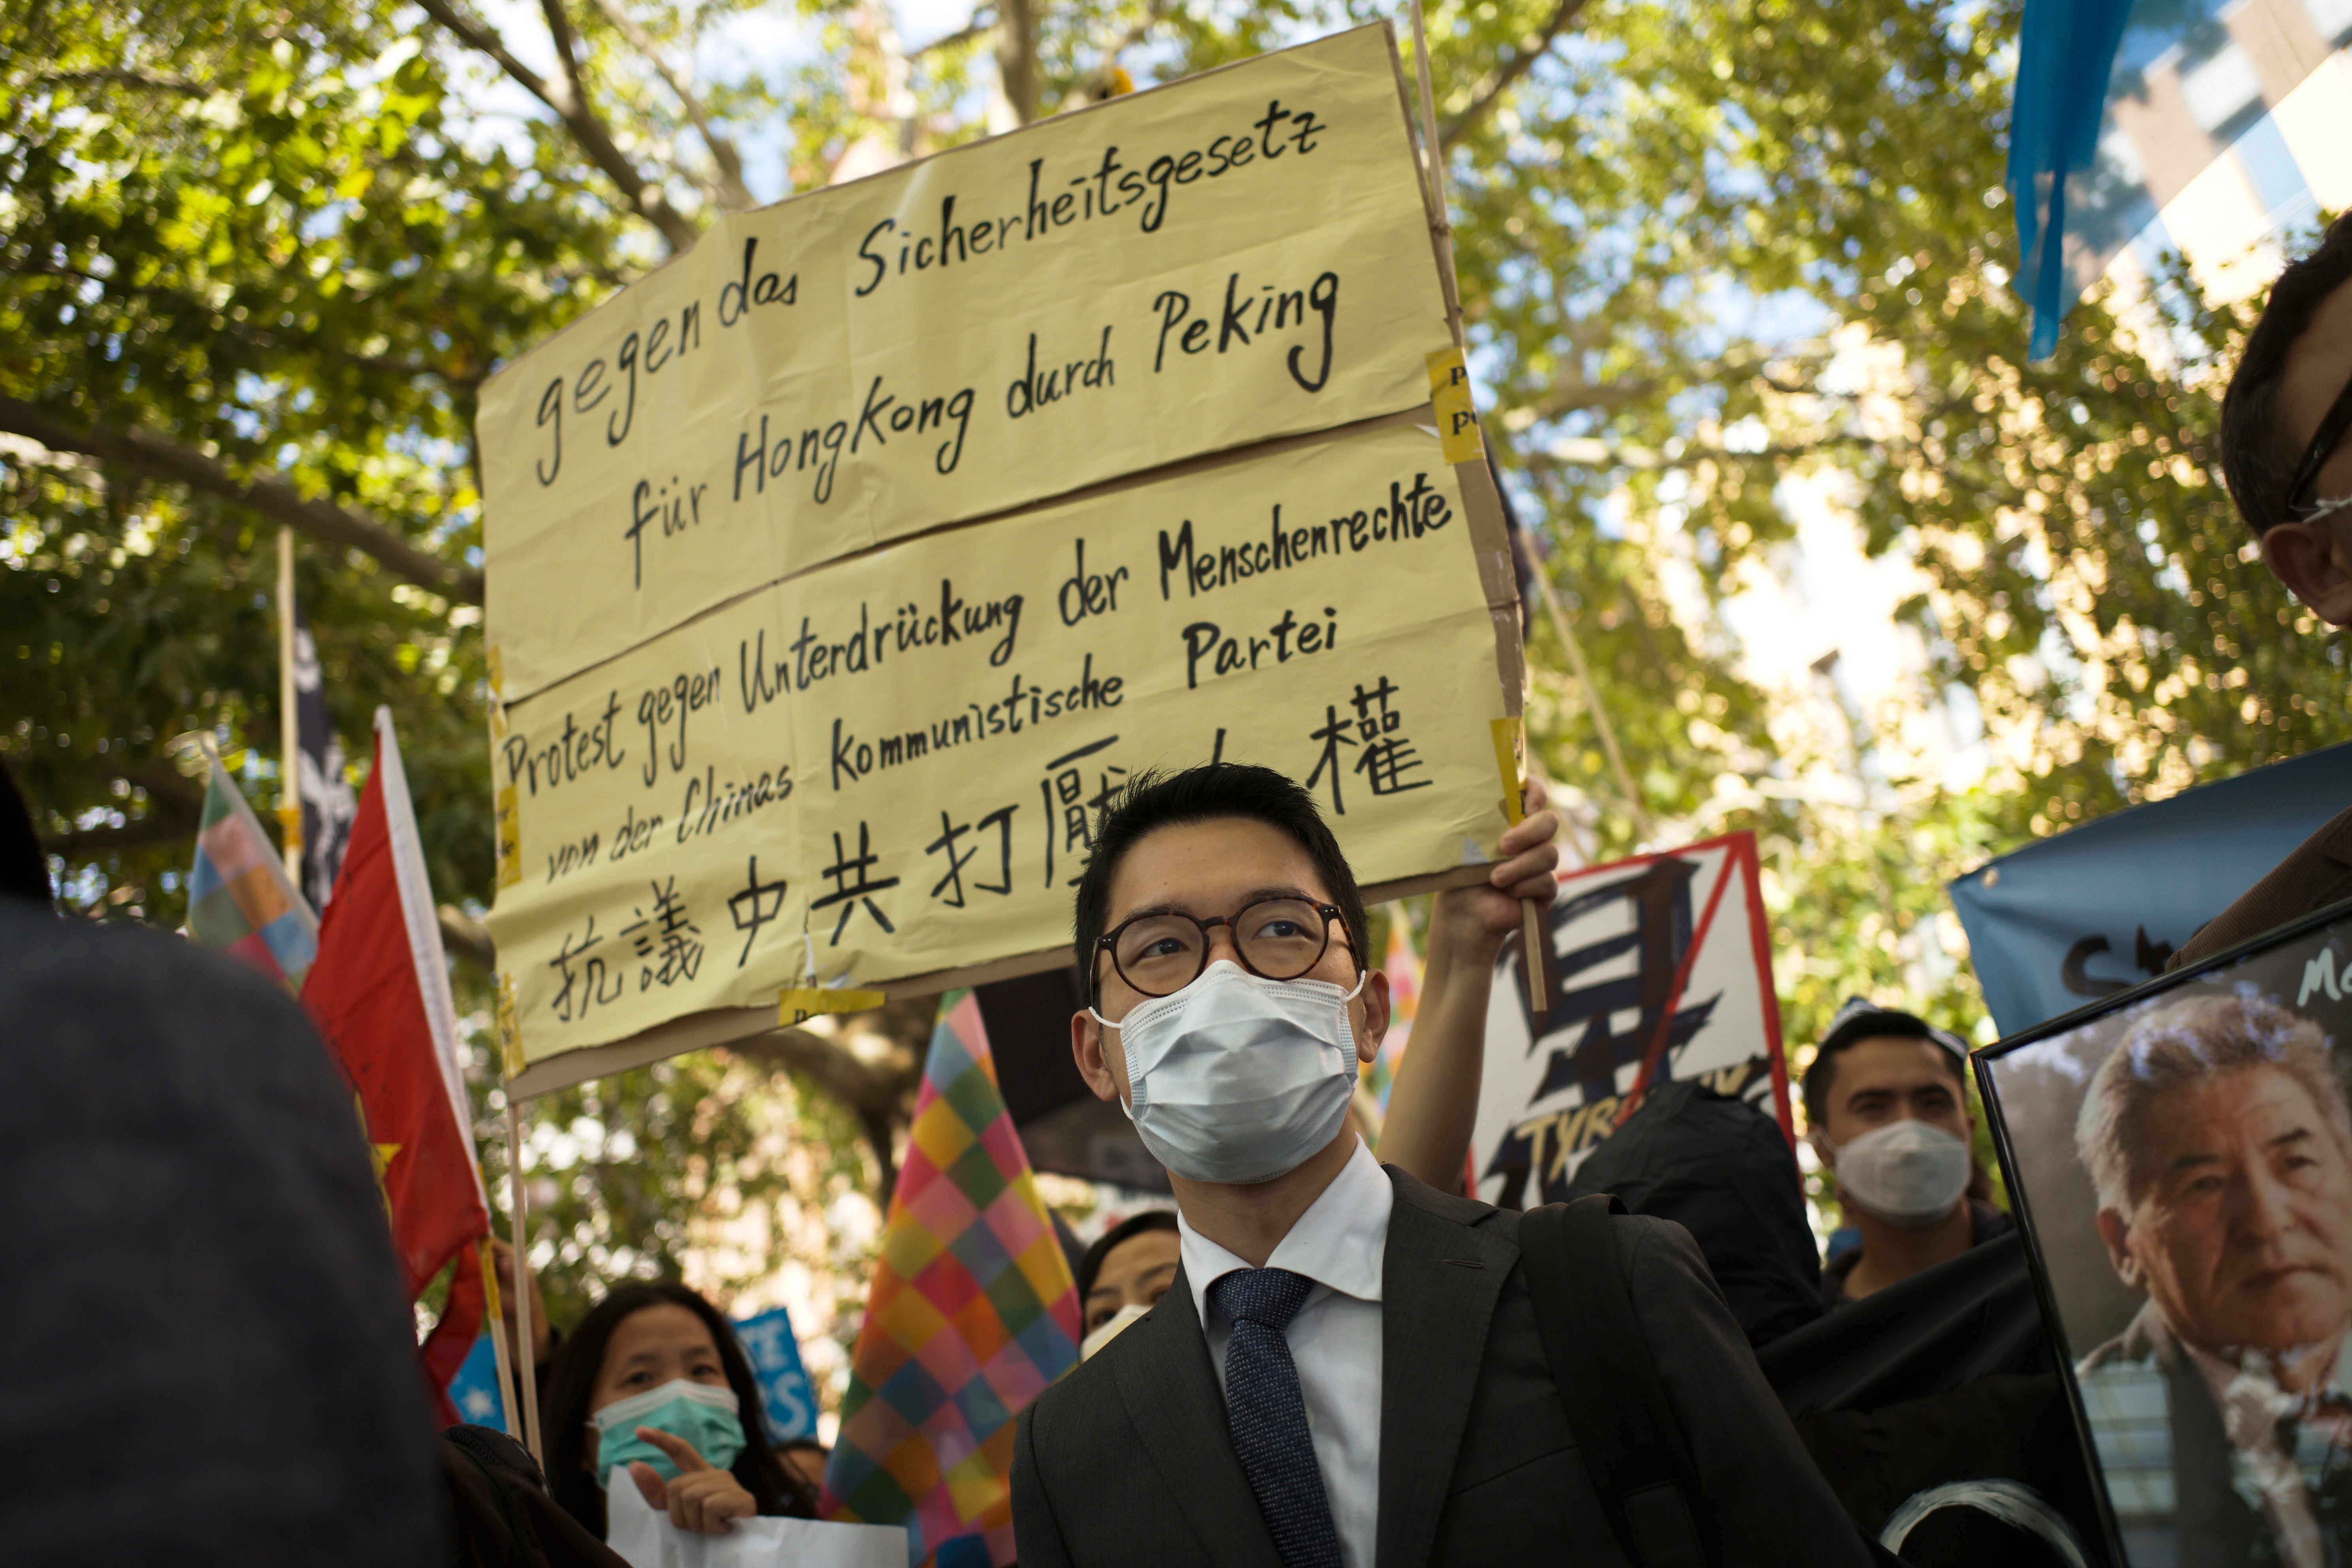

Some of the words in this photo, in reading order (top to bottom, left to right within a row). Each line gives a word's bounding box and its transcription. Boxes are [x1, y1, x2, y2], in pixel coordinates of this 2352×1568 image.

[537, 300, 699, 488] gegen
[719, 237, 797, 327] das
[855, 100, 1327, 298] Sicherheitsgesetz
[625, 476, 707, 590] für
[1008, 325, 1114, 418] durch
[1153, 271, 1338, 393] Peking
[503, 690, 624, 795] Protest
[638, 666, 720, 787] gegen
[741, 579, 1023, 714] Unterdrückung
[1059, 538, 1129, 626] der
[1159, 473, 1452, 600] Menschenrechte
[548, 832, 599, 883] von
[609, 805, 663, 861] der
[677, 766, 793, 843] Chinas
[1182, 607, 1337, 690] Partei
[549, 676, 1433, 1023] 抗議中共打壓權
